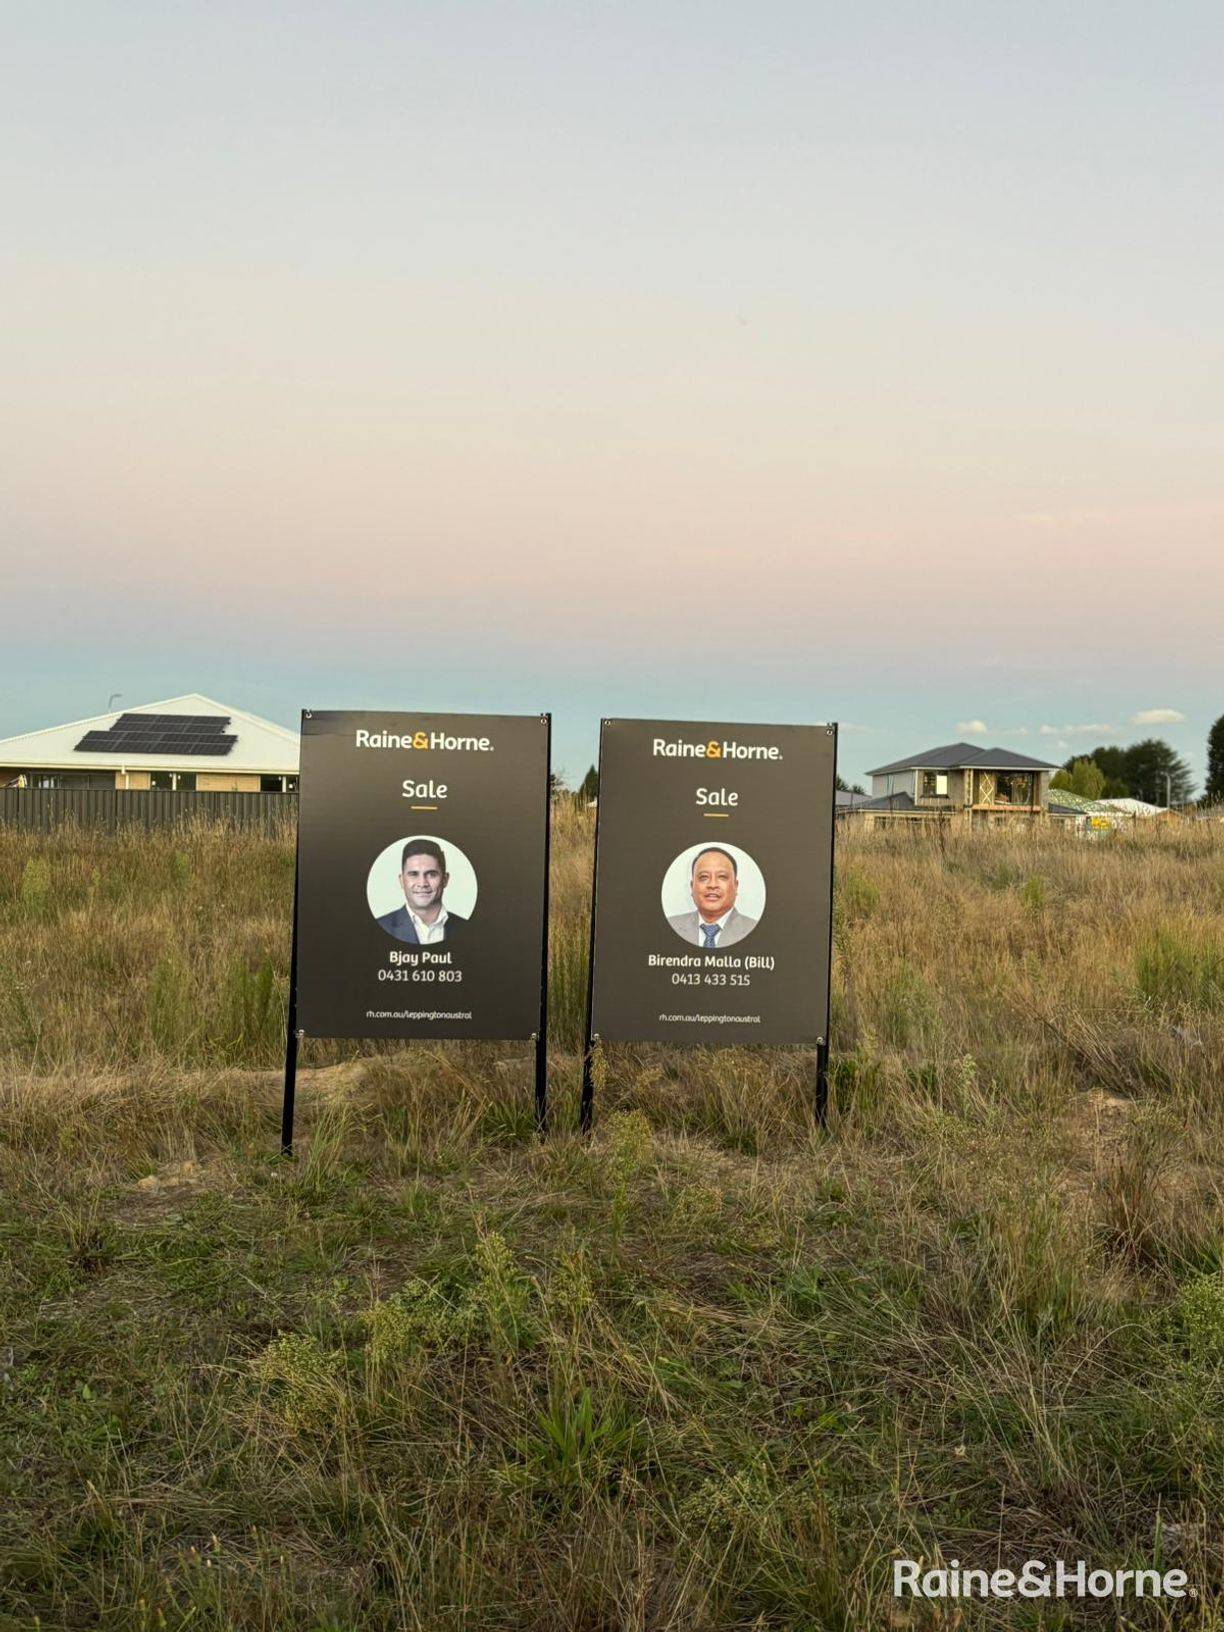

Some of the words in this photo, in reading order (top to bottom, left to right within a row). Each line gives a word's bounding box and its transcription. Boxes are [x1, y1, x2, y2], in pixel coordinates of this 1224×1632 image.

[402, 779, 448, 799] Sale
[696, 787, 739, 807] Sale
[389, 951, 419, 967] Bjay
[422, 952, 453, 964] Paul
[648, 954, 702, 967] Birendra
[704, 955, 741, 968] Malla
[744, 956, 775, 971] (Bill)
[378, 969, 409, 982] 0431
[412, 970, 435, 983] 610
[438, 970, 463, 983] 803
[671, 973, 701, 986] 0413
[704, 973, 727, 986] 433
[729, 974, 751, 987] 515
